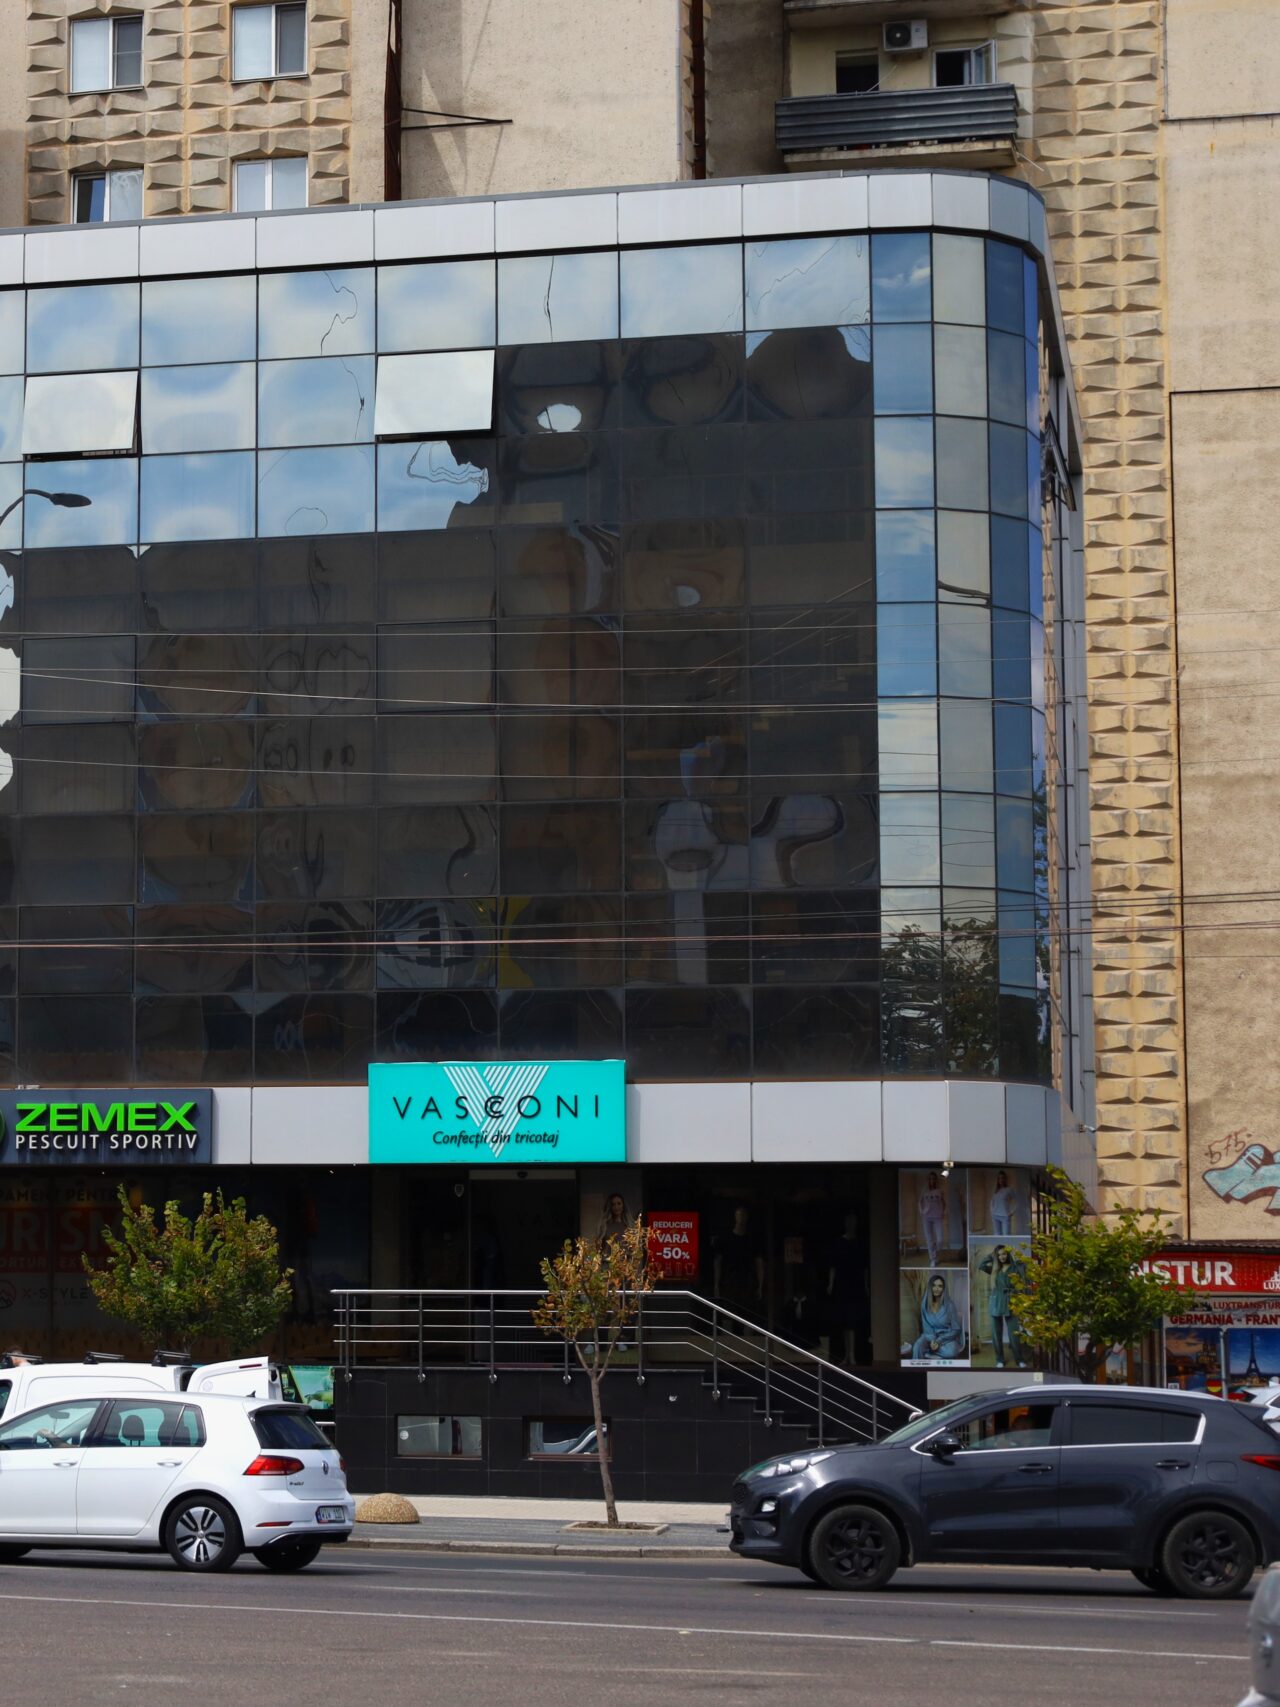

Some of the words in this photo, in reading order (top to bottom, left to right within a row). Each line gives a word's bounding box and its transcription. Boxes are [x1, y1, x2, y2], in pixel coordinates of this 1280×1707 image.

[393, 1094, 599, 1119] VASCONI
[16, 1103, 197, 1131] ZEMEX
[16, 1135, 101, 1149] PESCUIT
[110, 1134, 198, 1149] SPORTIV
[491, 1130, 511, 1144] din
[515, 1130, 560, 1147] tricotaj
[653, 1221, 693, 1229] REDUCERI
[656, 1231, 689, 1243] VARĂ
[656, 1247, 690, 1259] -50%
[1170, 1314, 1233, 1325] GERMANIA
